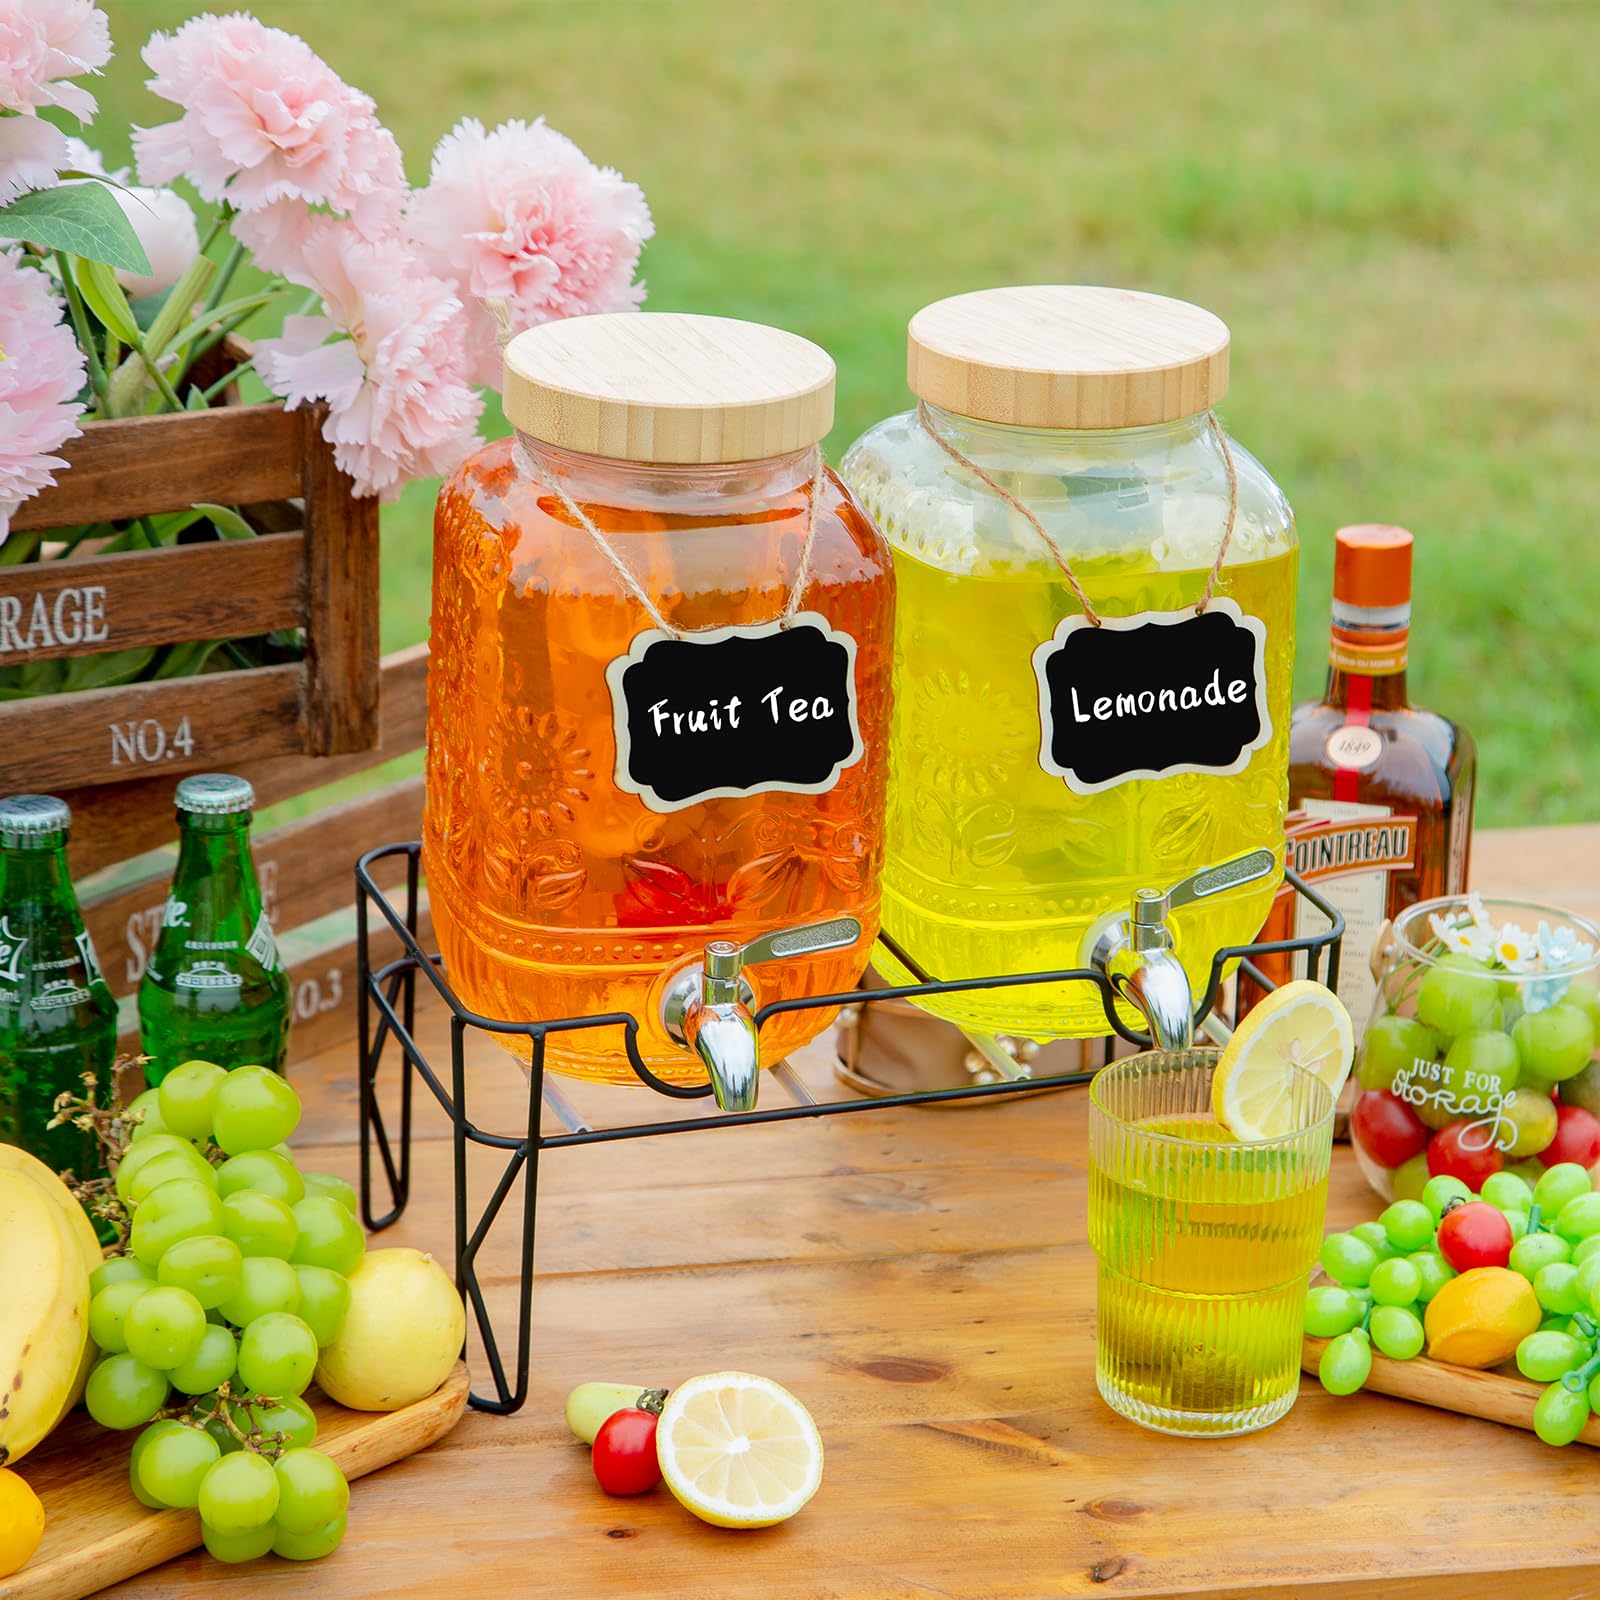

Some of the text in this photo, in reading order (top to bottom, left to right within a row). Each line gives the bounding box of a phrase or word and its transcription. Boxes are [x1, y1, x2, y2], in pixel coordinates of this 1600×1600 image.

[647, 686, 834, 736] Fruit Tea
[1071, 667, 1247, 723] Lemonade
[108, 714, 195, 764] NO.4
[1339, 739, 1371, 753] 1849
[292, 968, 343, 1024] O.3
[1411, 1057, 1502, 1094] JUST FOR
